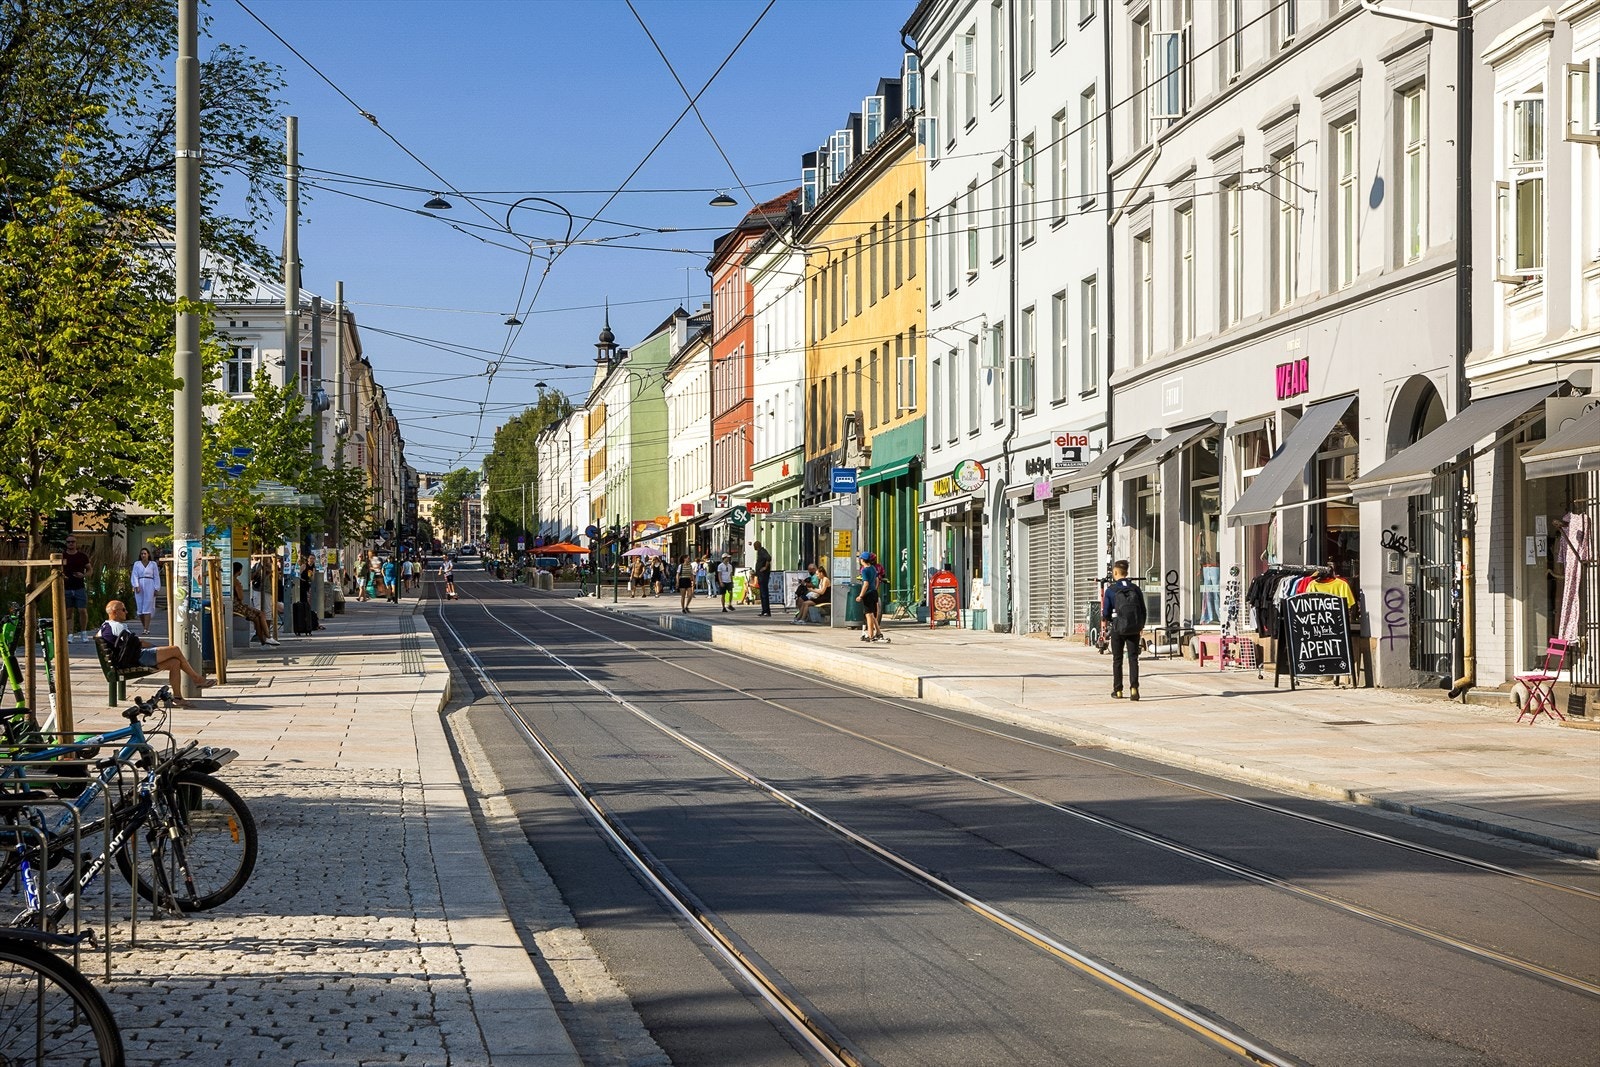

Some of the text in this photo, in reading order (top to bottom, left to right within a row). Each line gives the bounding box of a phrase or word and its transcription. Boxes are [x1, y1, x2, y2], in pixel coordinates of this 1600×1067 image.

[1276, 356, 1309, 400] WEAR
[1055, 433, 1088, 447] elna
[1290, 597, 1341, 613] VINTAGE
[1295, 611, 1336, 625] WEAR
[1301, 626, 1311, 640] by
[1298, 637, 1342, 660] ÅPENT
